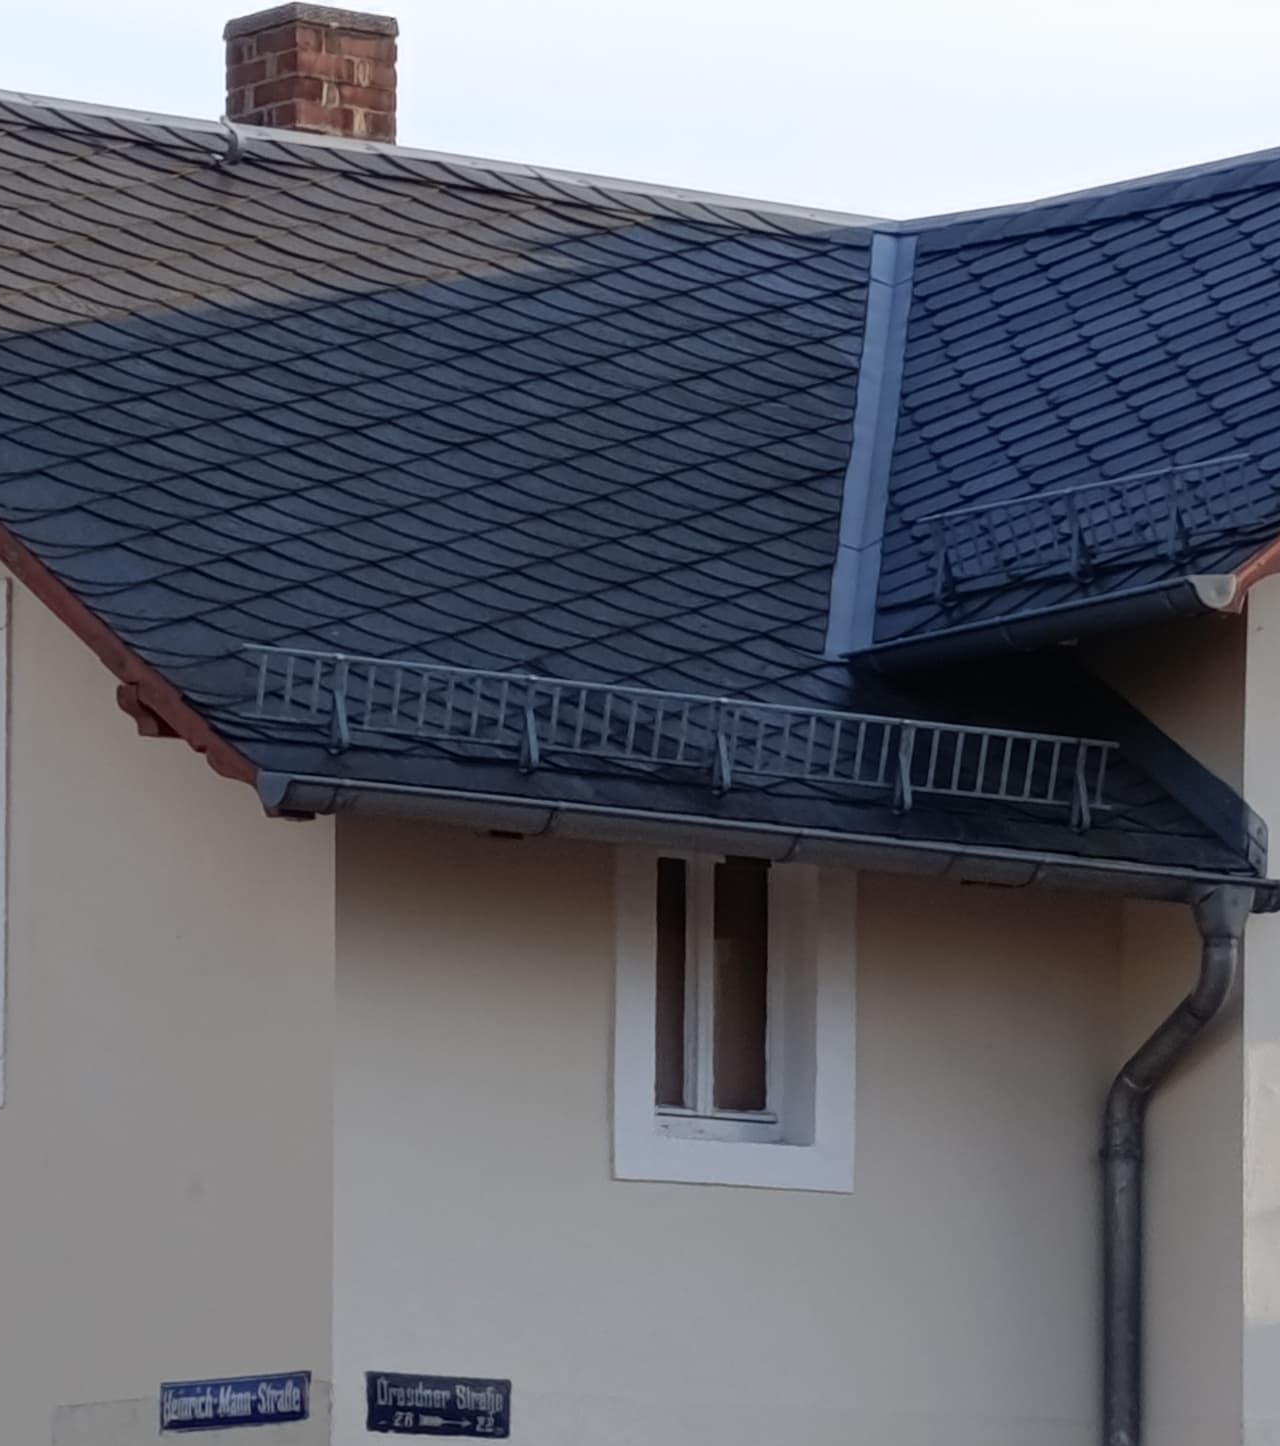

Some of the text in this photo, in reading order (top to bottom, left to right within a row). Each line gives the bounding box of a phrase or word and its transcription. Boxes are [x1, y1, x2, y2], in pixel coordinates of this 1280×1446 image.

[163, 1380, 301, 1427] Heinrich-Mann-Straße
[376, 1376, 504, 1414] Dresdner Straße
